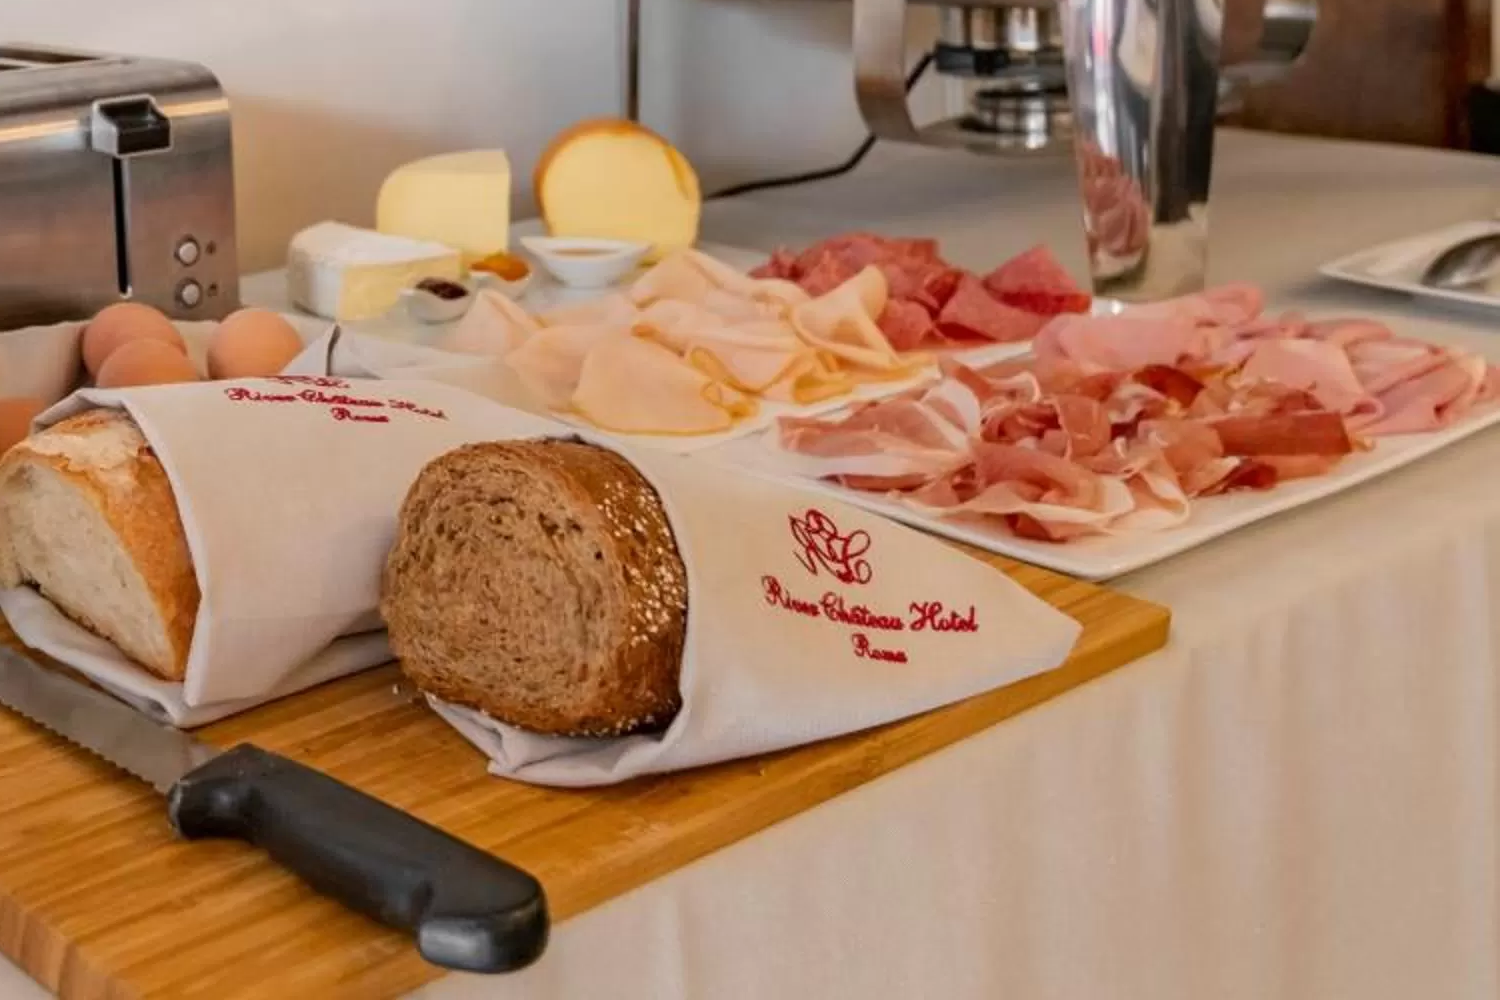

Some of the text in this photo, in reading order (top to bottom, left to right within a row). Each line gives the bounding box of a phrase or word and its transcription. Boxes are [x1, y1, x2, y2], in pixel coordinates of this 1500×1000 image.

[329, 406, 391, 423] Roma
[761, 575, 821, 618] River
[909, 601, 980, 633] Hotel
[851, 632, 909, 665] Roma
